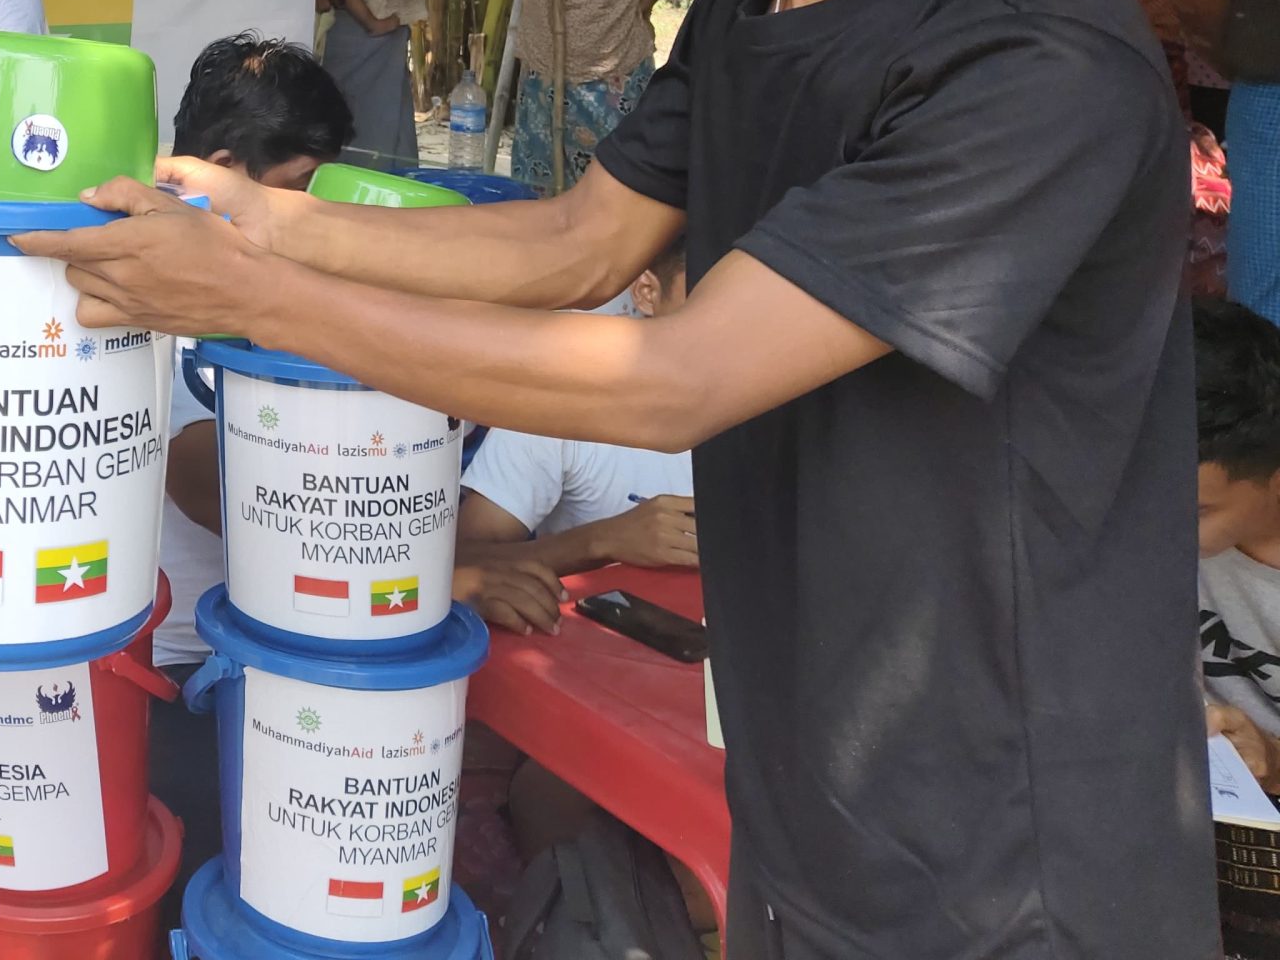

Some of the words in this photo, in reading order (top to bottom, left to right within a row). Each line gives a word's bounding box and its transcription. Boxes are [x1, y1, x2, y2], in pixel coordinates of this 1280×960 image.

[105, 330, 152, 351] mdmc
[0, 407, 153, 453] INDONESIA
[227, 421, 329, 456] MuhammadiyahAid
[337, 442, 387, 457] lazismu
[412, 436, 445, 452] mdmc
[95, 433, 164, 480] GEMPA
[302, 471, 410, 494] BANTUAN
[255, 485, 338, 518] RAKYAT
[344, 488, 446, 518] INDONESIA
[241, 500, 304, 536] UNTUK
[310, 520, 402, 542] KORBAN
[408, 506, 455, 537] GEMPA
[301, 541, 411, 565] MYANMAR
[252, 718, 374, 759] MuhammadiyahAid
[381, 745, 426, 760] lazismu
[344, 768, 441, 797] BANTUAN
[288, 787, 379, 820] RAKYAT
[268, 802, 343, 841] UNTUK
[349, 816, 433, 843] KORBAN
[338, 836, 438, 866] MYANMAR
